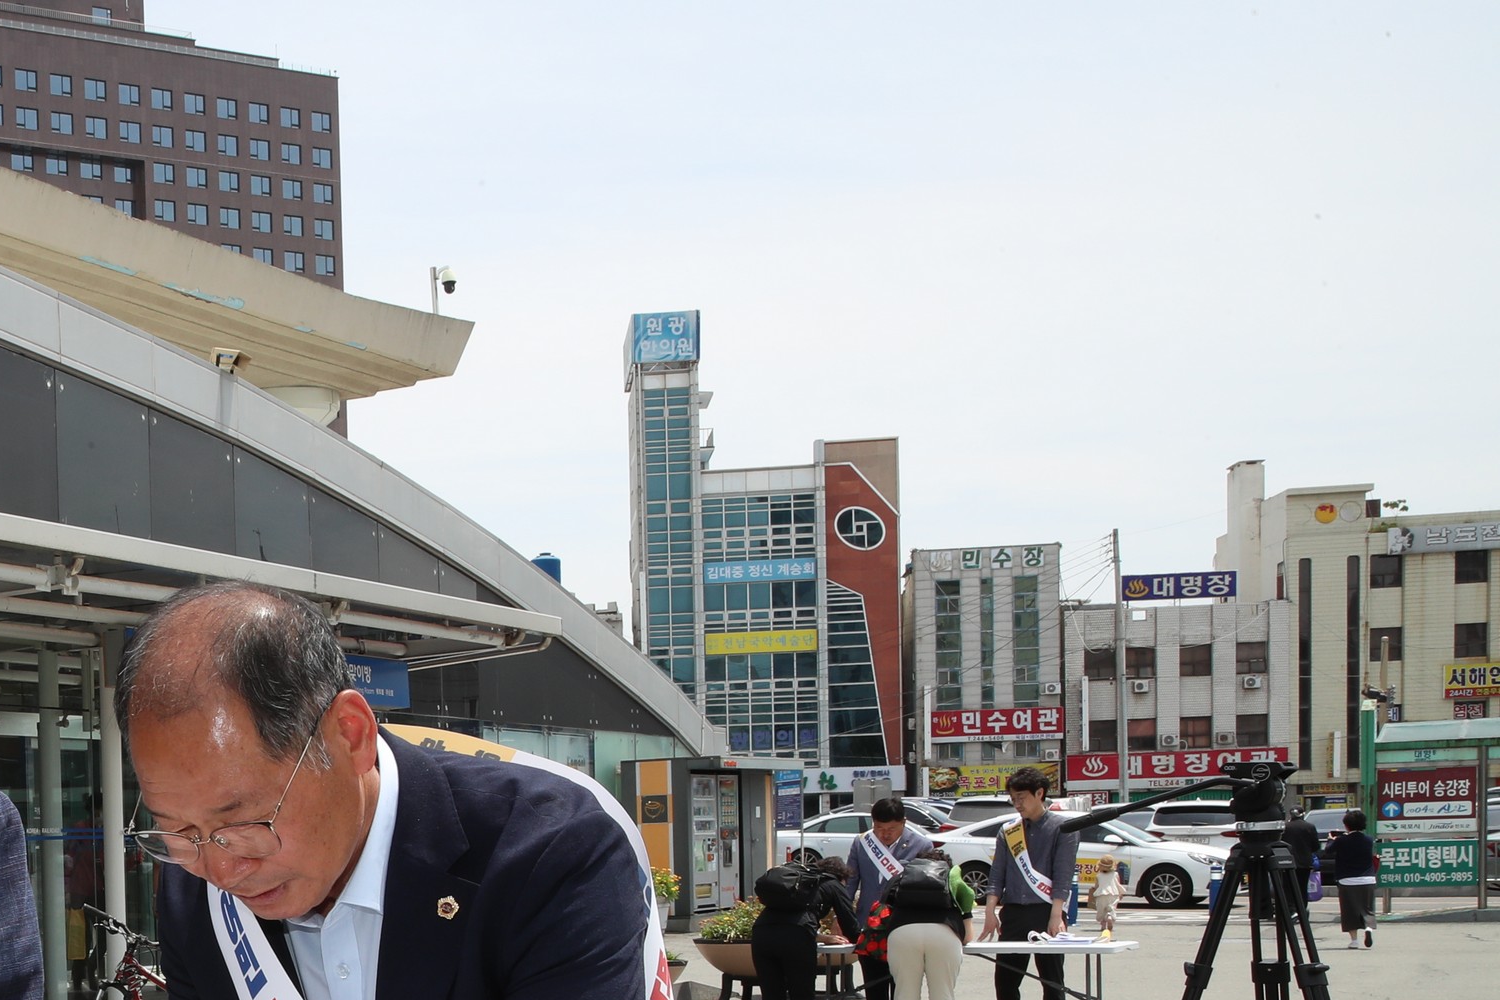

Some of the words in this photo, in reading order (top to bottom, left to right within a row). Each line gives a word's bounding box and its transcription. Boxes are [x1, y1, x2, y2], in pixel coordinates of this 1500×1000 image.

[640, 338, 693, 356] 한의원
[961, 547, 1044, 569] 민수장
[707, 566, 744, 580] 김대중
[748, 563, 773, 577] 정신
[777, 561, 815, 576] 계승회
[1153, 575, 1232, 597] 대명장
[348, 664, 372, 684] 맞이방
[1449, 689, 1473, 697] 24시간
[1476, 688, 1500, 697] 연중무
[961, 709, 1060, 734] 민수여관
[958, 775, 1000, 790] 목포의
[1382, 780, 1430, 798] 시티투어
[1433, 779, 1471, 797] 승강장
[1380, 844, 1473, 870] 목포대형택시
[1380, 874, 1401, 883] 연락처
[1403, 871, 1473, 883] 010-4905-9895
